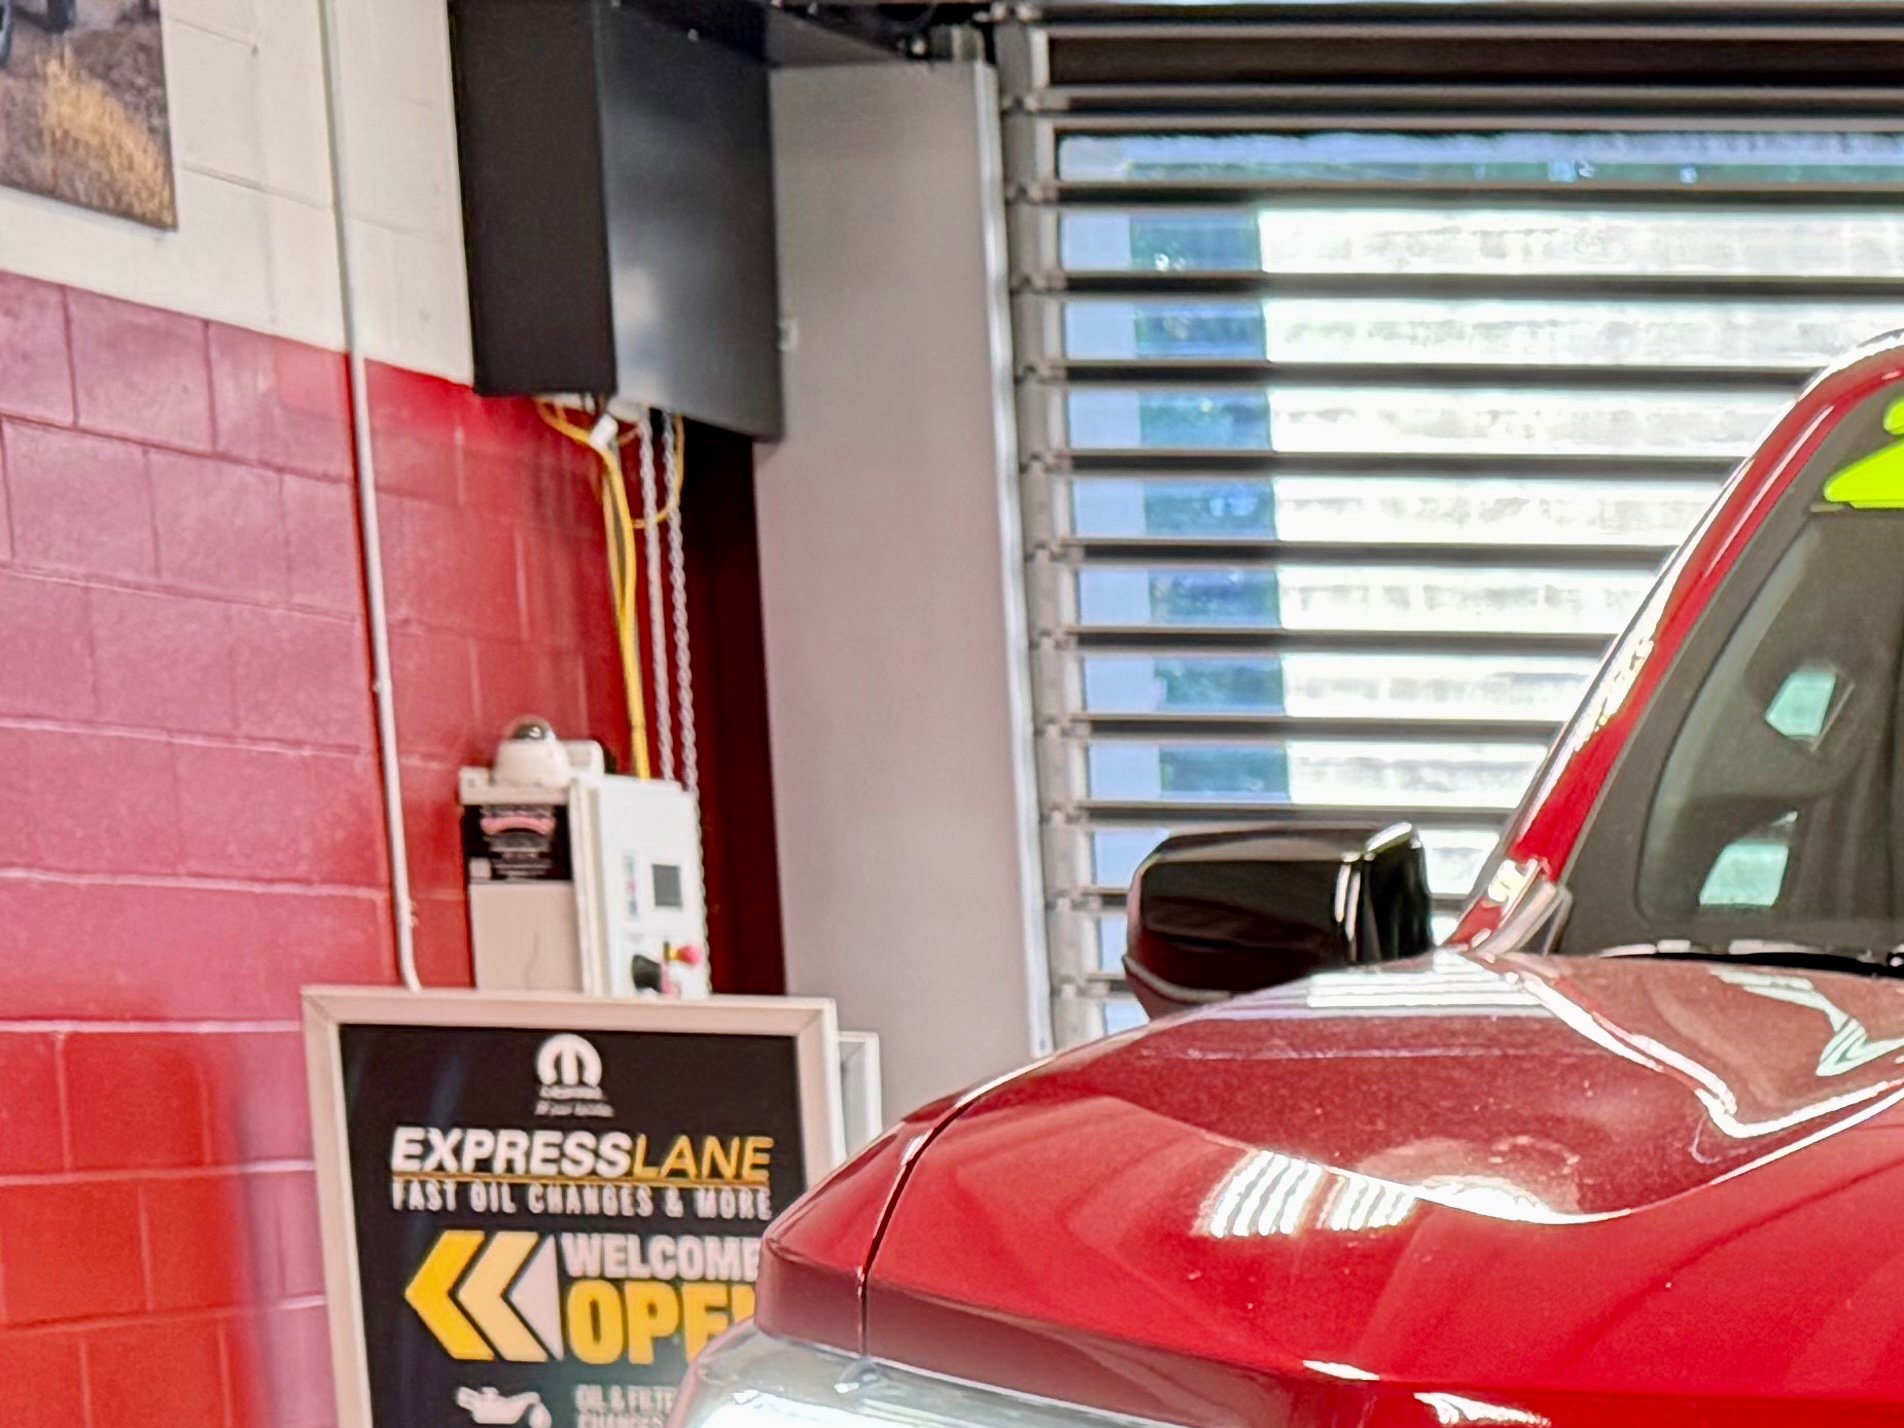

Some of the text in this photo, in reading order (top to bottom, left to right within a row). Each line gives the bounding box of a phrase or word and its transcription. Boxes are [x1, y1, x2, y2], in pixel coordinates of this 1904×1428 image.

[392, 1180, 772, 1221] FAST OIL CHANGES & MORE
[560, 1232, 761, 1282] WELCOME
[567, 1280, 756, 1366] OPE
